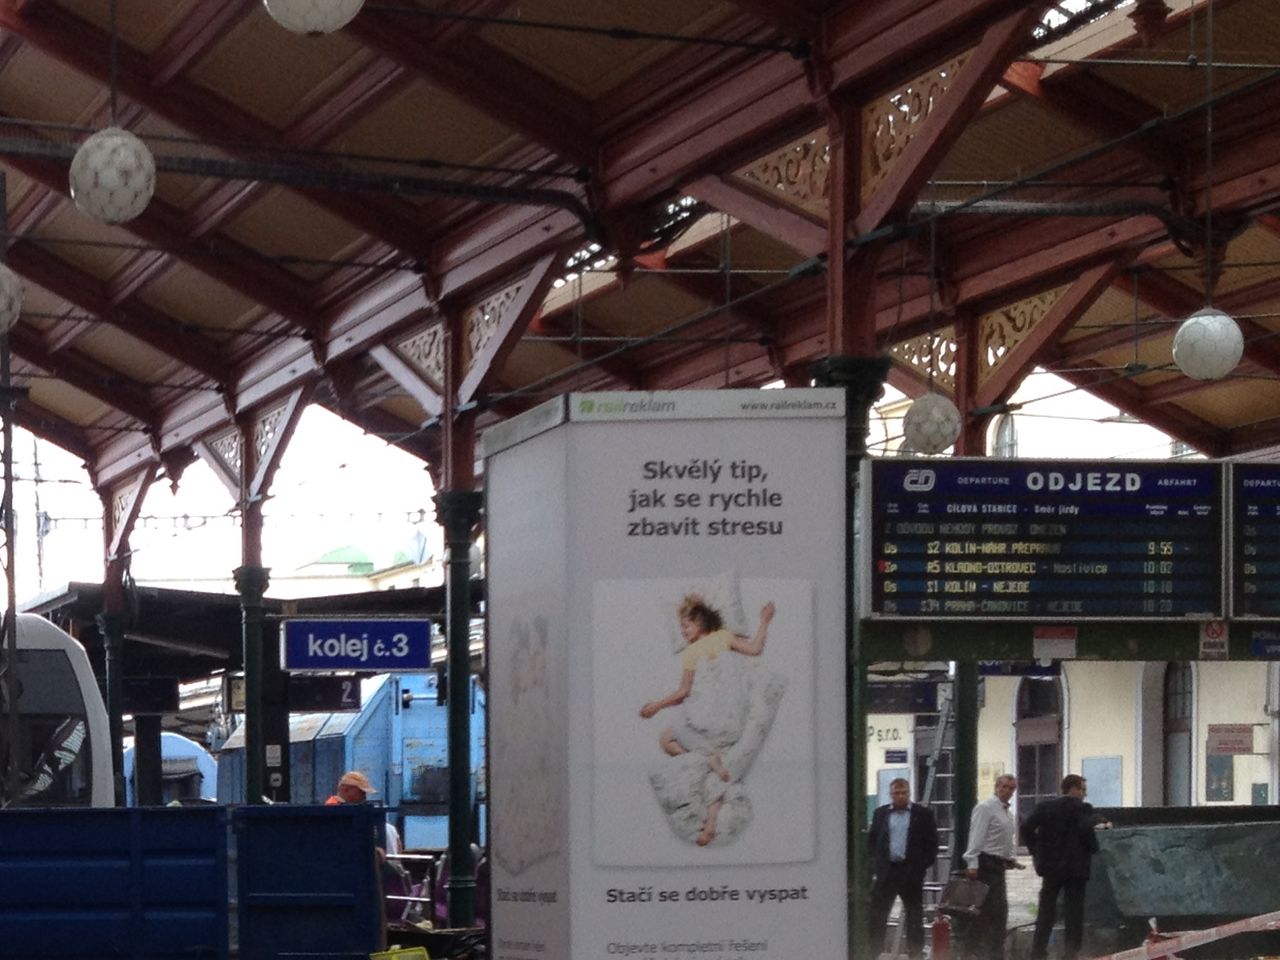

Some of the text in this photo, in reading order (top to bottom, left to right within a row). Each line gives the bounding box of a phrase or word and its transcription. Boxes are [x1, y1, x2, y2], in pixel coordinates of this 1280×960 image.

[643, 459, 768, 483] Skvělý tip,
[1026, 471, 1142, 492] ODJEZD
[628, 489, 783, 512] jak se rychle
[628, 517, 783, 536] zbavit stresu
[308, 634, 369, 662] kolej
[606, 885, 809, 904] Stačí se dobře vyspat
